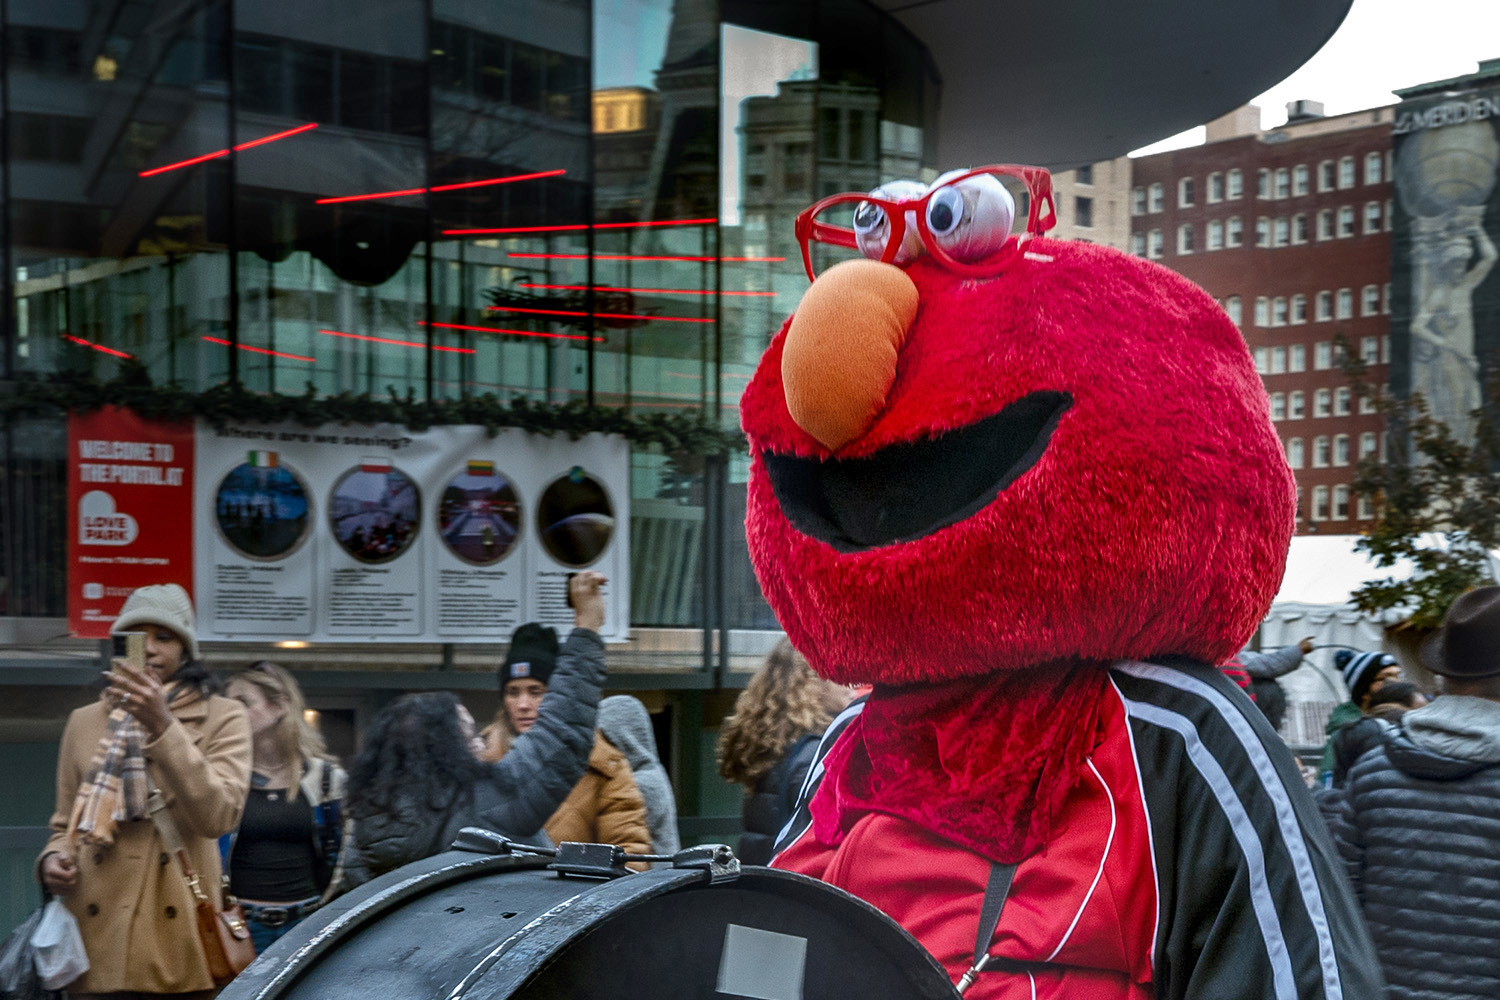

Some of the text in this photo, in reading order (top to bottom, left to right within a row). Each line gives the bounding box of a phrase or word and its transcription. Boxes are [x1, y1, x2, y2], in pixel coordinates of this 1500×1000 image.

[1412, 97, 1500, 129] MERIDIEN
[78, 439, 174, 462] WELCOME TO
[279, 433, 310, 443] are
[313, 435, 339, 445] we
[342, 435, 412, 449] seeing?
[78, 463, 109, 482] THE
[109, 464, 166, 485] PORTAL
[85, 517, 127, 528] LOVE
[86, 530, 128, 541] PARK
